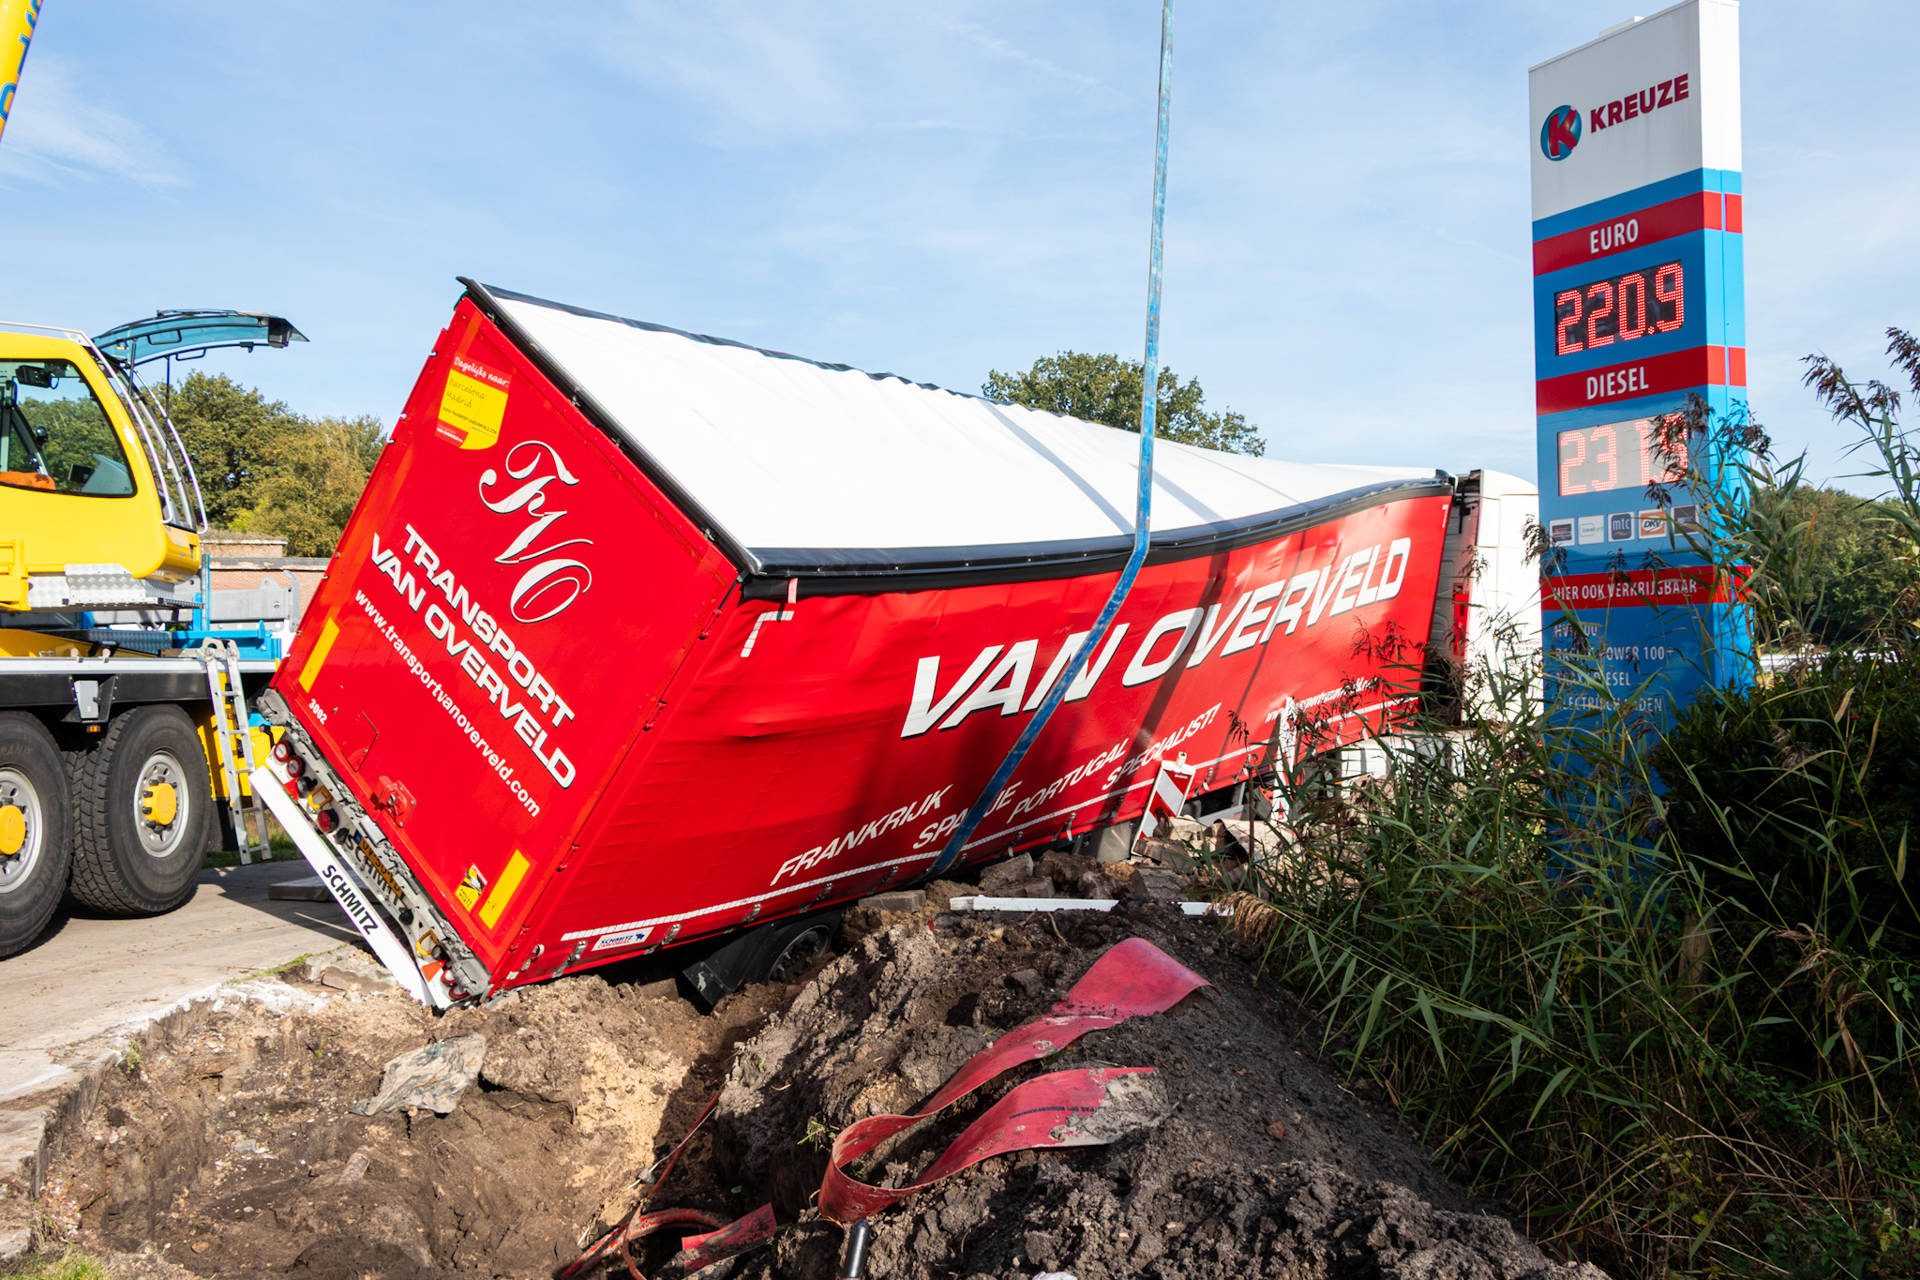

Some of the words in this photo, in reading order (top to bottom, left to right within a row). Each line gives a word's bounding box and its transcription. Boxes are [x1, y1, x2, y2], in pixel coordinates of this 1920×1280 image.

[1590, 73, 1689, 133] KREUZE
[1589, 218, 1639, 254] EURO
[1557, 262, 1685, 355] 220.9
[1586, 366, 1649, 400] DIESEL
[403, 522, 576, 729] TRANSPORT
[1553, 585, 1579, 601] HIER
[1582, 583, 1605, 600] OOK
[371, 531, 428, 613] VAN
[424, 602, 577, 789] OVERVELD
[899, 621, 1131, 740] VAN
[1121, 536, 1412, 689] OVERVELD
[1643, 645, 1665, 660] 100
[354, 588, 542, 819] www.transportvanoverveld.com
[1101, 702, 1222, 791] SPECIALIST!
[912, 780, 1023, 850] SPAJE
[1006, 738, 1130, 825] PORTUGAL
[769, 783, 954, 887] FRANKRIJK
[321, 863, 380, 936] SCHMITZ
